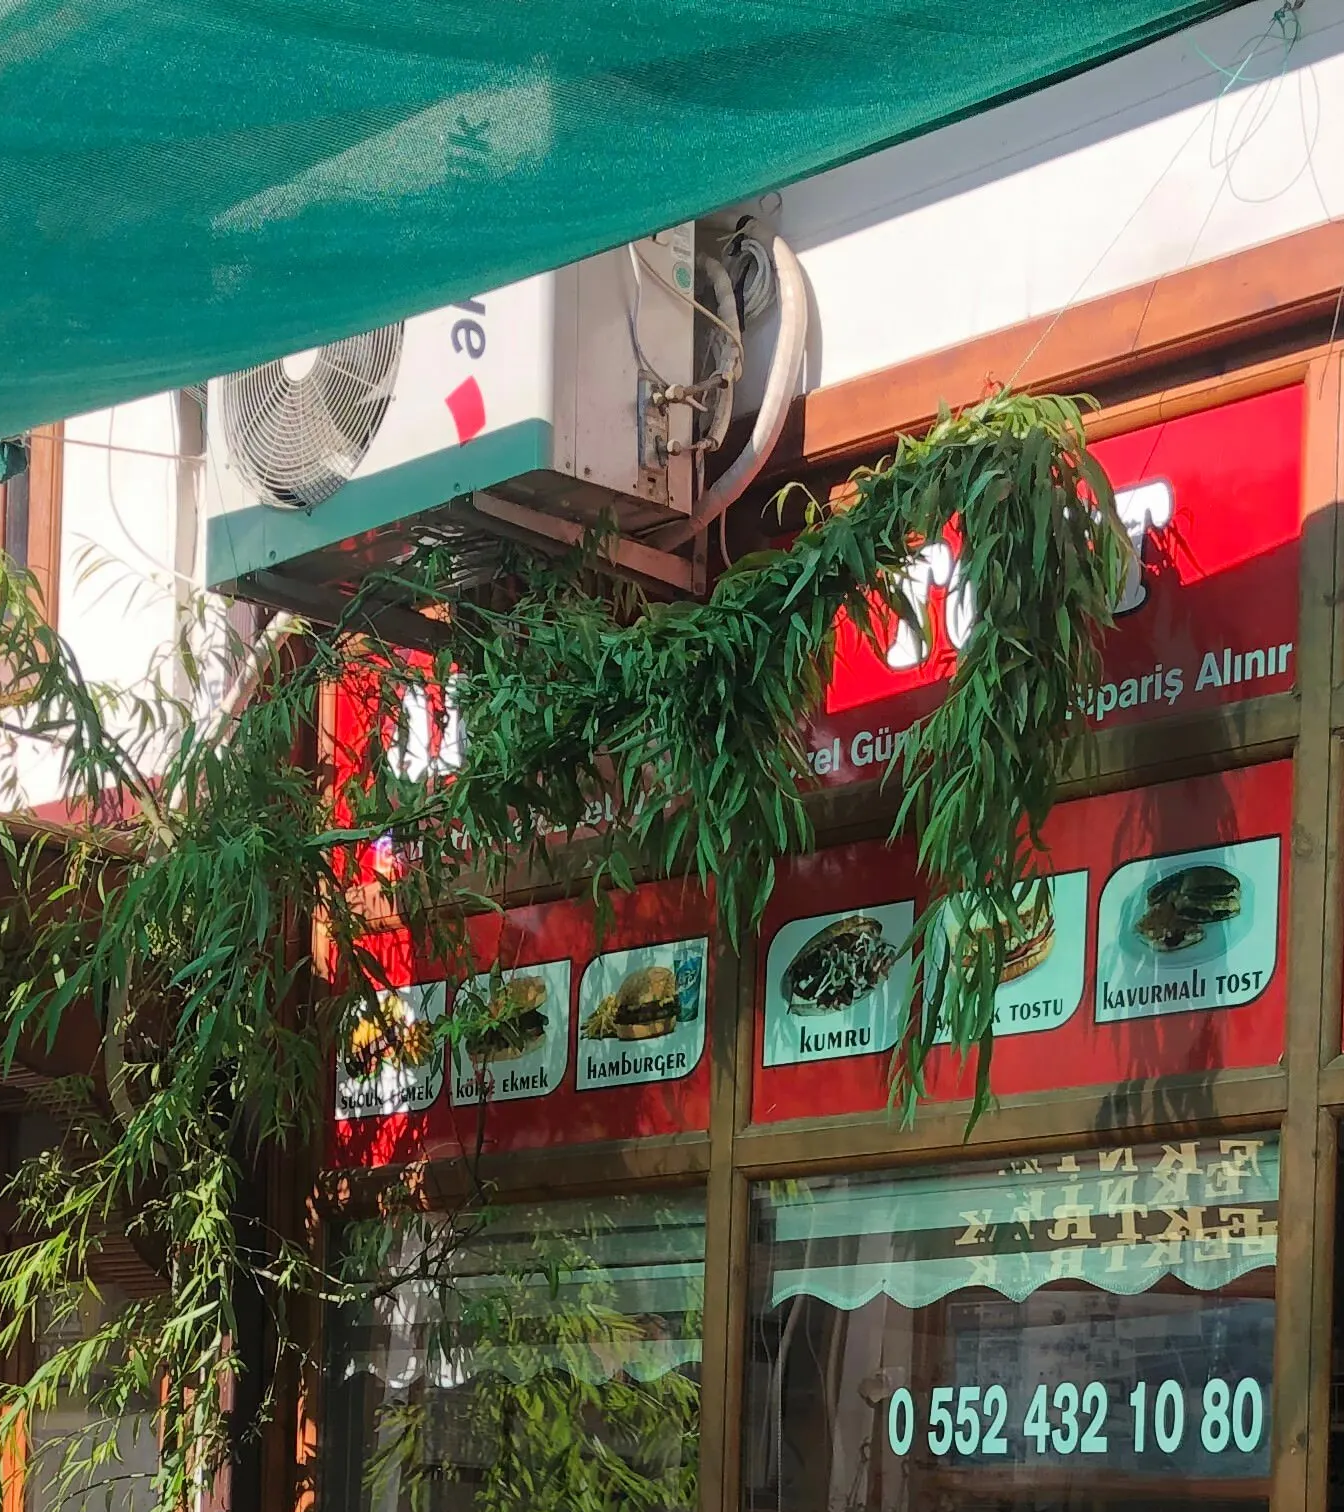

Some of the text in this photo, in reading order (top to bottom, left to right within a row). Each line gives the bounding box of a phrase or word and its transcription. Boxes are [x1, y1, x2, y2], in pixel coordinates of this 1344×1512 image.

[1194, 642, 1294, 692] Alınır
[1102, 969, 1264, 1011] KAVURMALI TOST
[1009, 997, 1064, 1023] TOSTU
[799, 1025, 872, 1055] KUMRU
[587, 1049, 687, 1080] HAMBURGER
[502, 1070, 549, 1093] EKMEK
[888, 1377, 1263, 1456] 0 552 432 10 80
